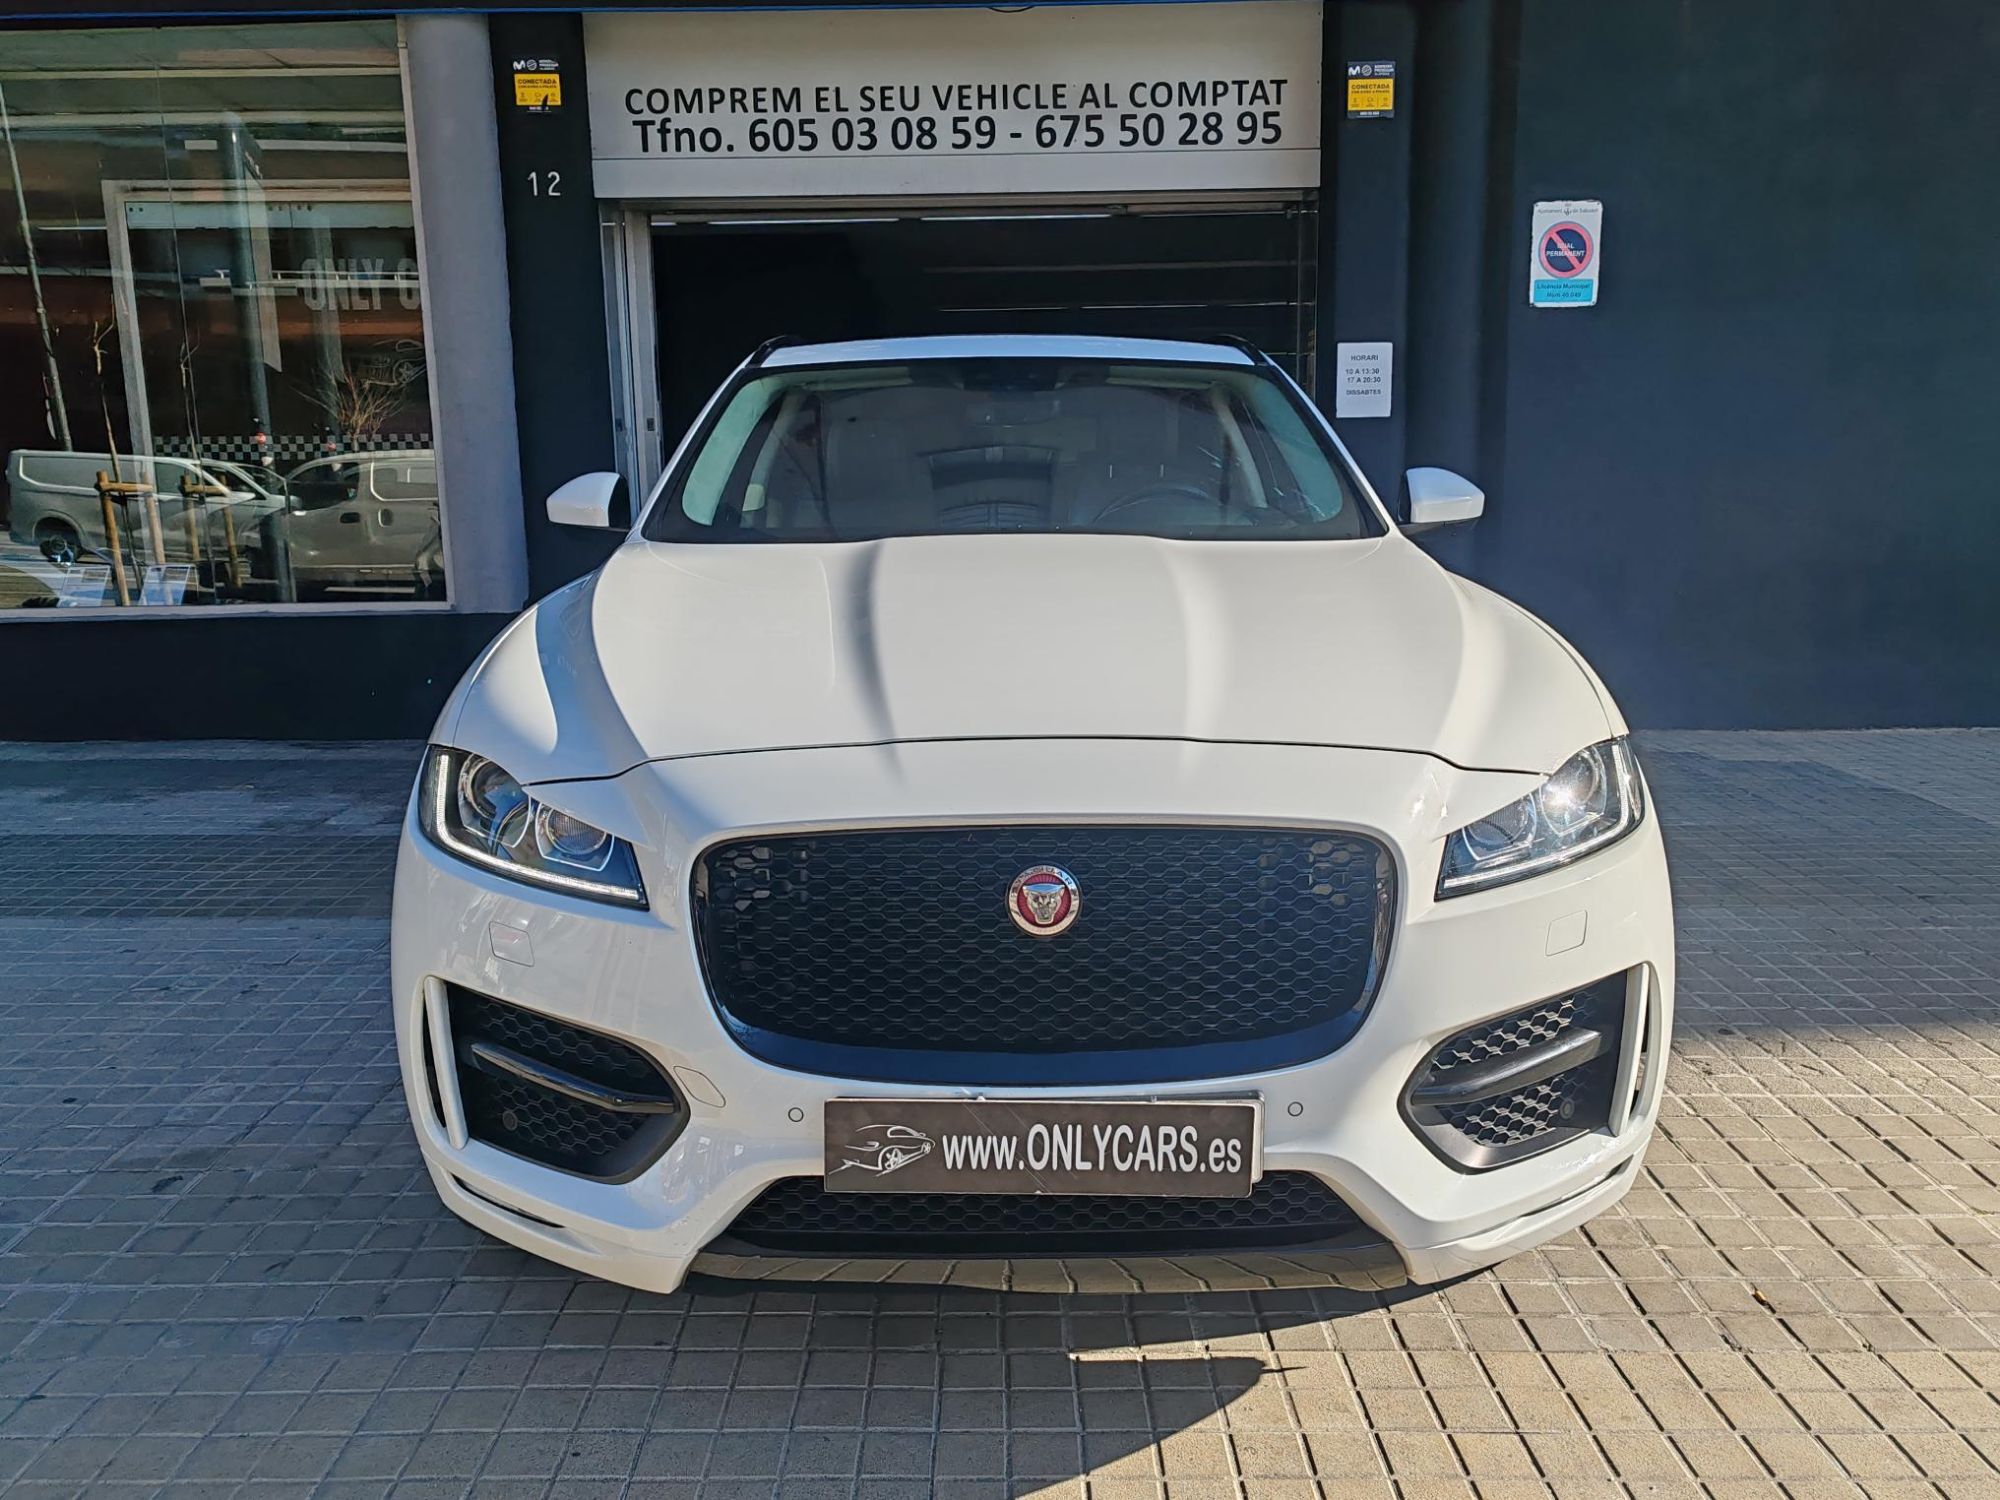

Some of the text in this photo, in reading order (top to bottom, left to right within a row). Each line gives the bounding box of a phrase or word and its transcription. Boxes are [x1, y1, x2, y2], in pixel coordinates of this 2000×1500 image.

[625, 79, 1289, 116] COMPREM EL SEU VEHICLE AL COMPTAT
[632, 117, 735, 154] Tfno.
[749, 117, 819, 152] 605
[832, 117, 878, 152] 03
[891, 116, 938, 151] 08
[952, 115, 996, 150] 59
[1036, 114, 1105, 149] 675
[1120, 113, 1165, 148] 50
[1179, 112, 1224, 147] 28
[1237, 110, 1283, 146] 95
[528, 171, 561, 196] 12
[301, 258, 384, 311] ONLY
[1362, 367, 1380, 375] 13:30
[942, 1123, 1243, 1173] www.ONLYCARS.es
